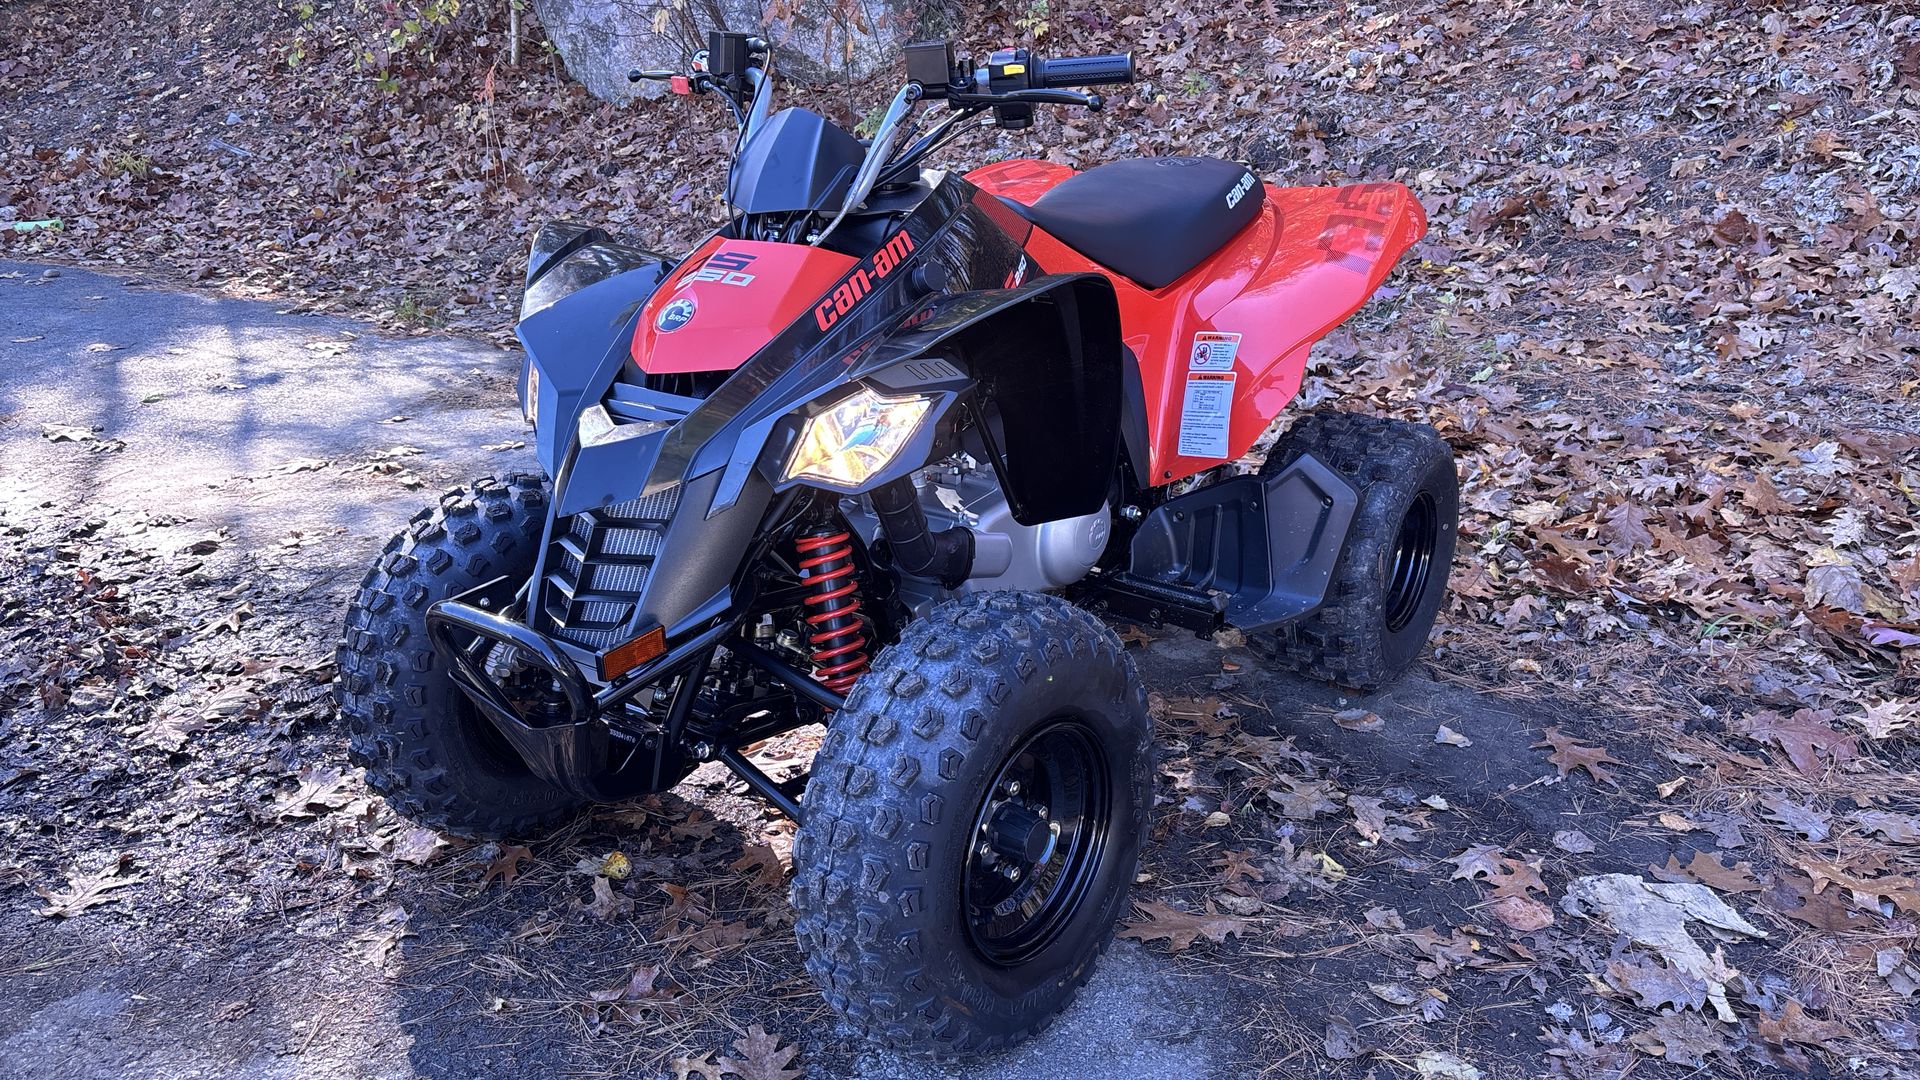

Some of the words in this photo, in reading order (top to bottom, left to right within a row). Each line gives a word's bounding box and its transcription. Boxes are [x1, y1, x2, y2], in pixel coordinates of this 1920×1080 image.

[1225, 171, 1256, 209] can-am
[814, 229, 915, 333] can-am
[667, 313, 688, 323] BRP
